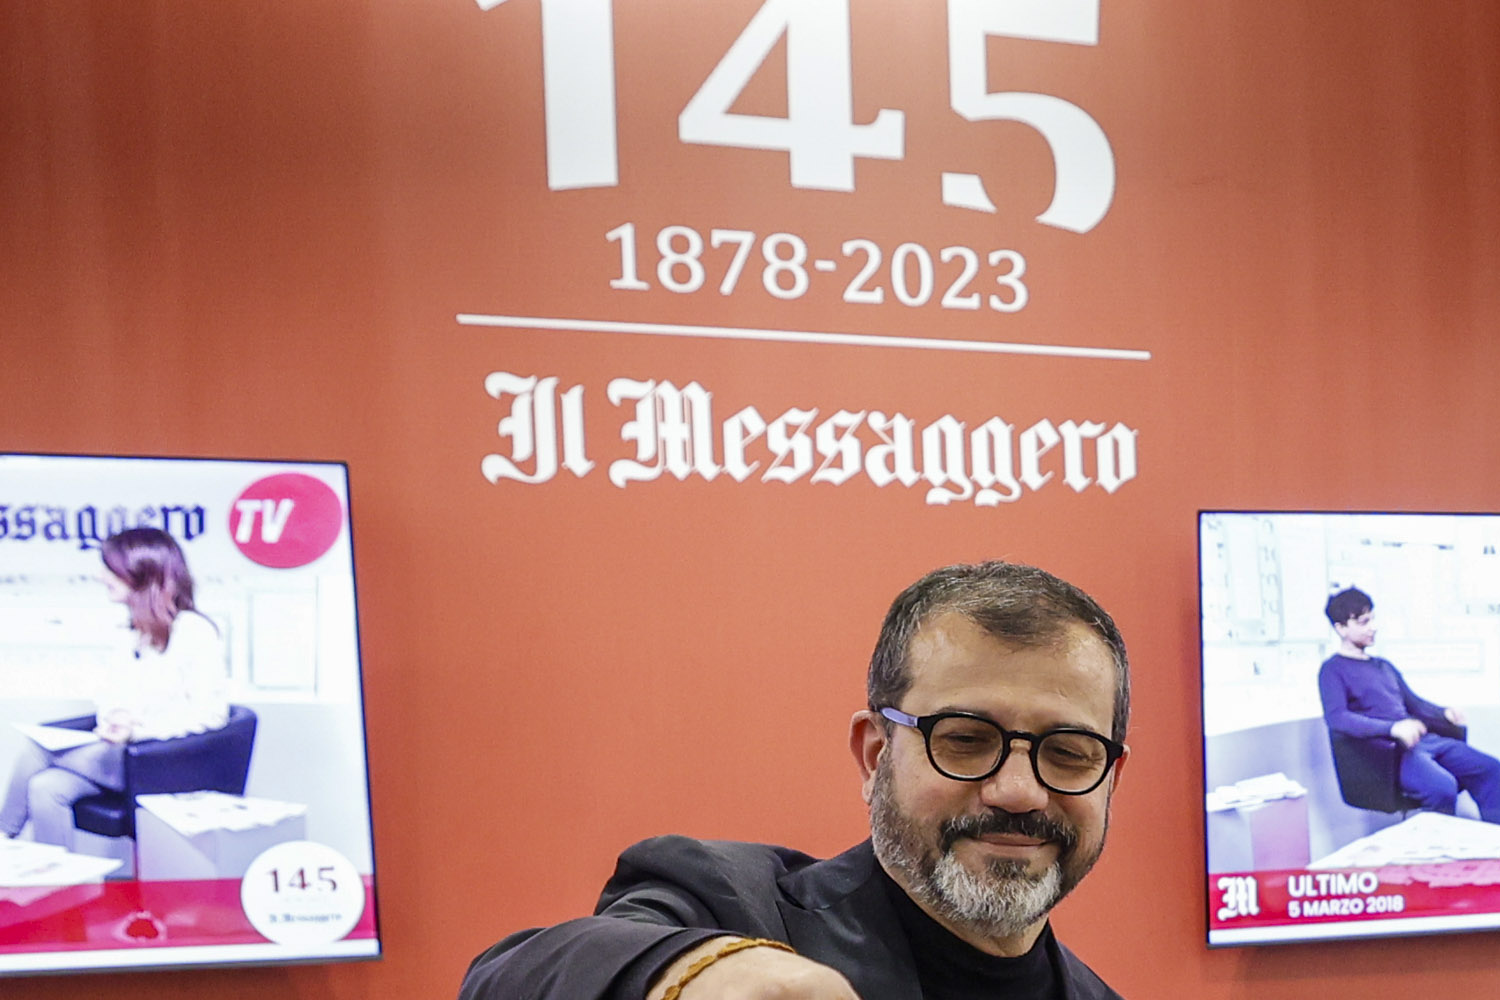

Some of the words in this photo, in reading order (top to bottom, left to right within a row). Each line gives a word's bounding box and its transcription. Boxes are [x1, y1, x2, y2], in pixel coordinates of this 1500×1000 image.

[475, 0, 1116, 234] 145
[606, 222, 1029, 313] 1878-2023
[481, 371, 595, 486] Il
[606, 377, 1139, 507] Messaggero
[235, 499, 293, 544] TV
[266, 865, 338, 893] 145
[1288, 872, 1379, 898] ULTIMO
[1288, 900, 1301, 918] 5
[1302, 898, 1365, 917] MARZO
[1366, 895, 1405, 914] 2018
